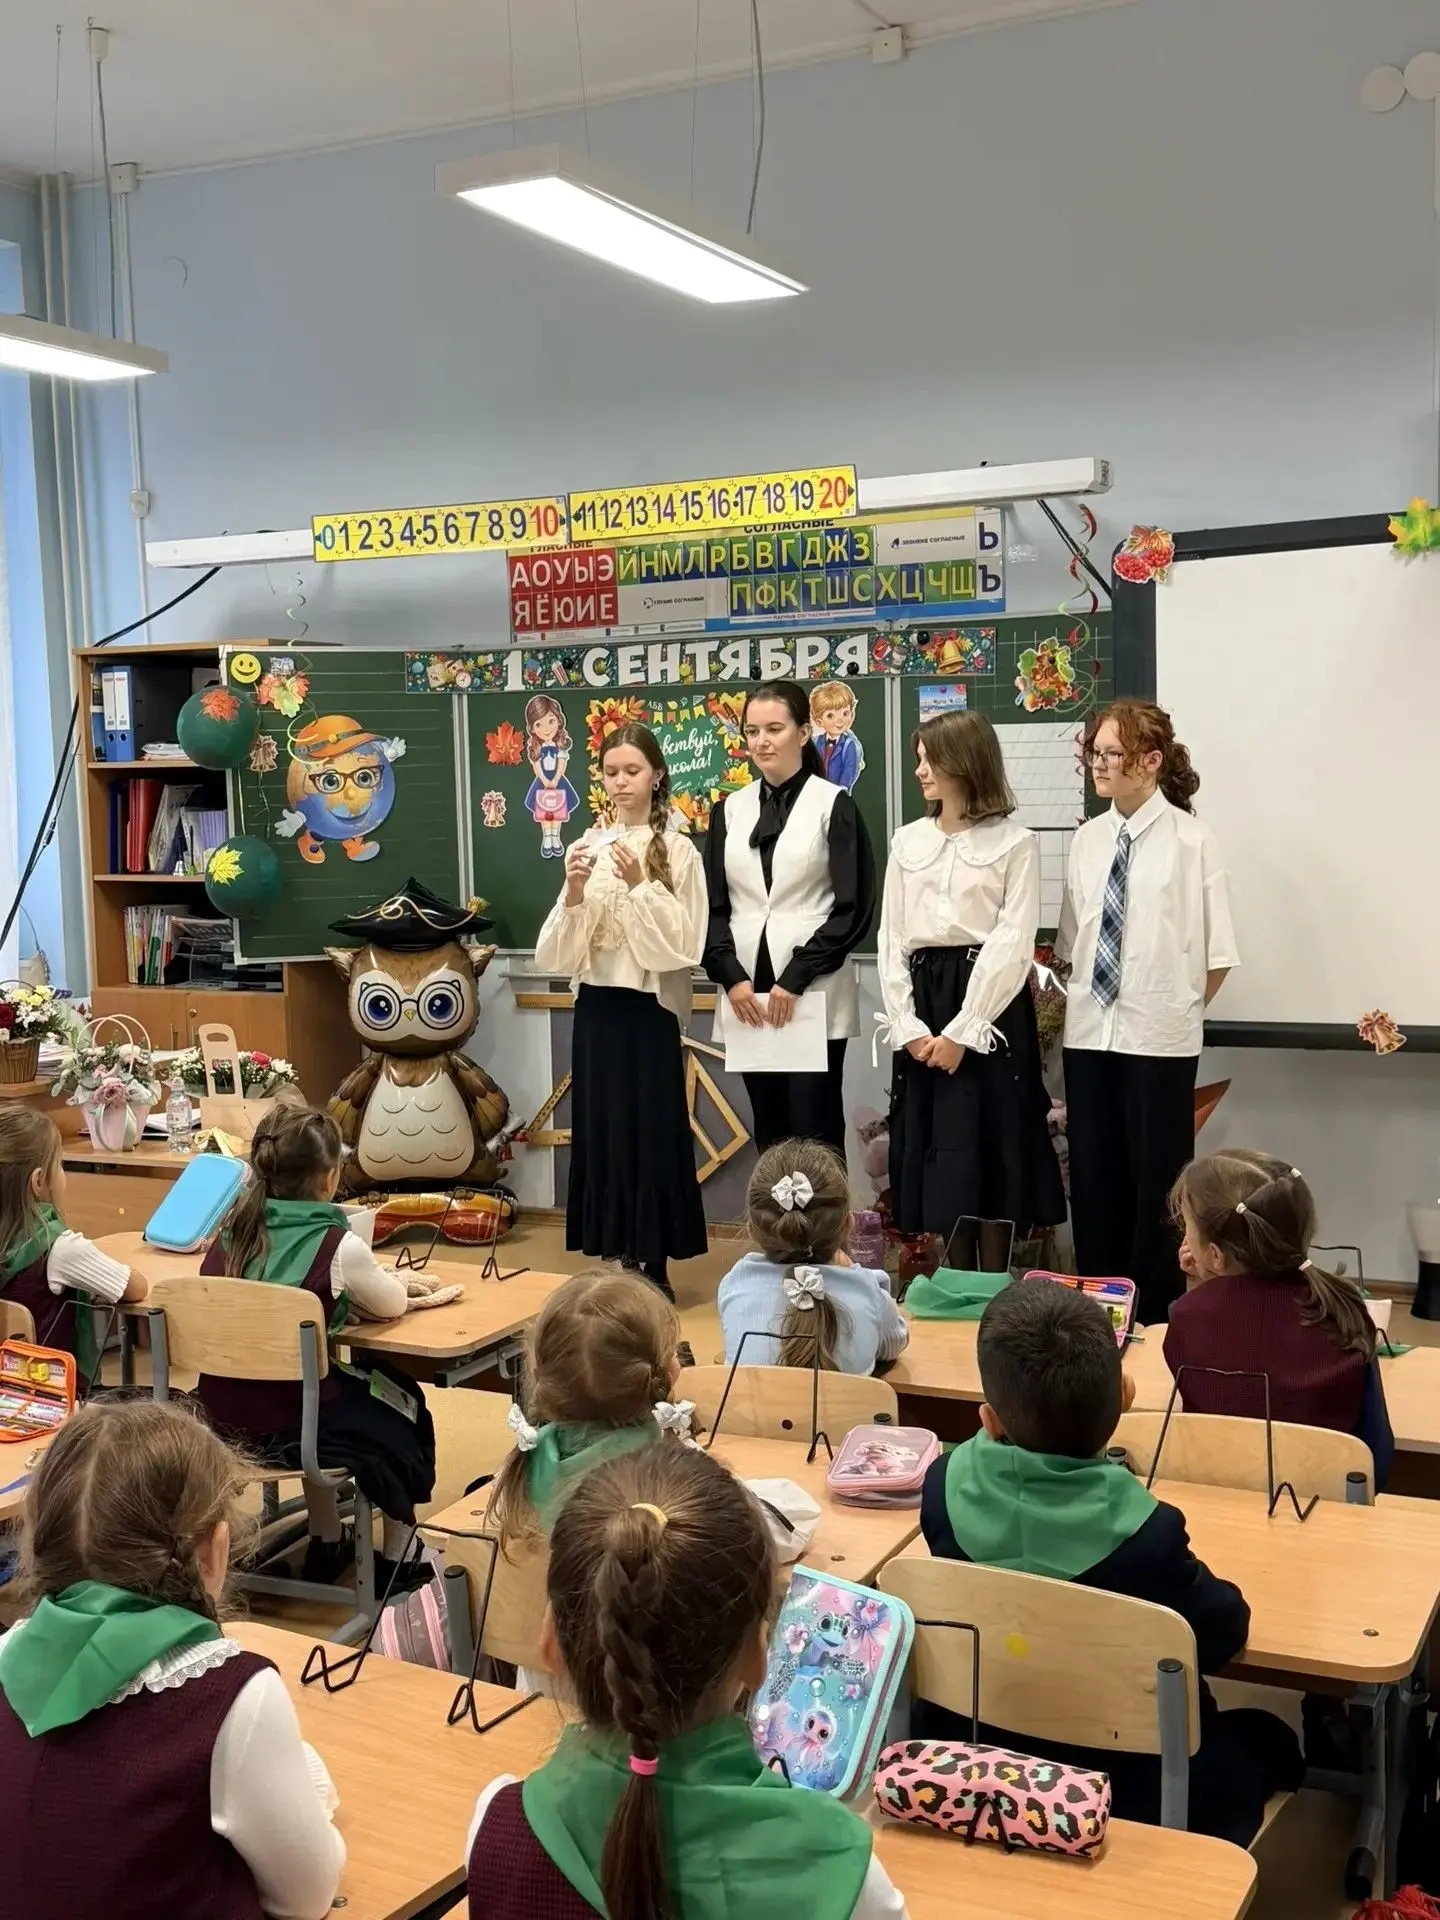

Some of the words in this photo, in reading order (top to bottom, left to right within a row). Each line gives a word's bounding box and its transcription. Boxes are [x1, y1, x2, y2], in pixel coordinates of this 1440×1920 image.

[579, 501, 596, 530] 11
[601, 499, 622, 528] 12
[627, 497, 648, 526] 13
[653, 494, 676, 524] 14
[681, 491, 703, 521] 15
[708, 488, 730, 519] 16
[736, 485, 757, 516] 17
[763, 483, 785, 514] 18
[791, 480, 813, 511] 19
[819, 477, 847, 508] 20
[502, 650, 525, 691] 1
[582, 634, 868, 687] СЕНТЯБРЯ
